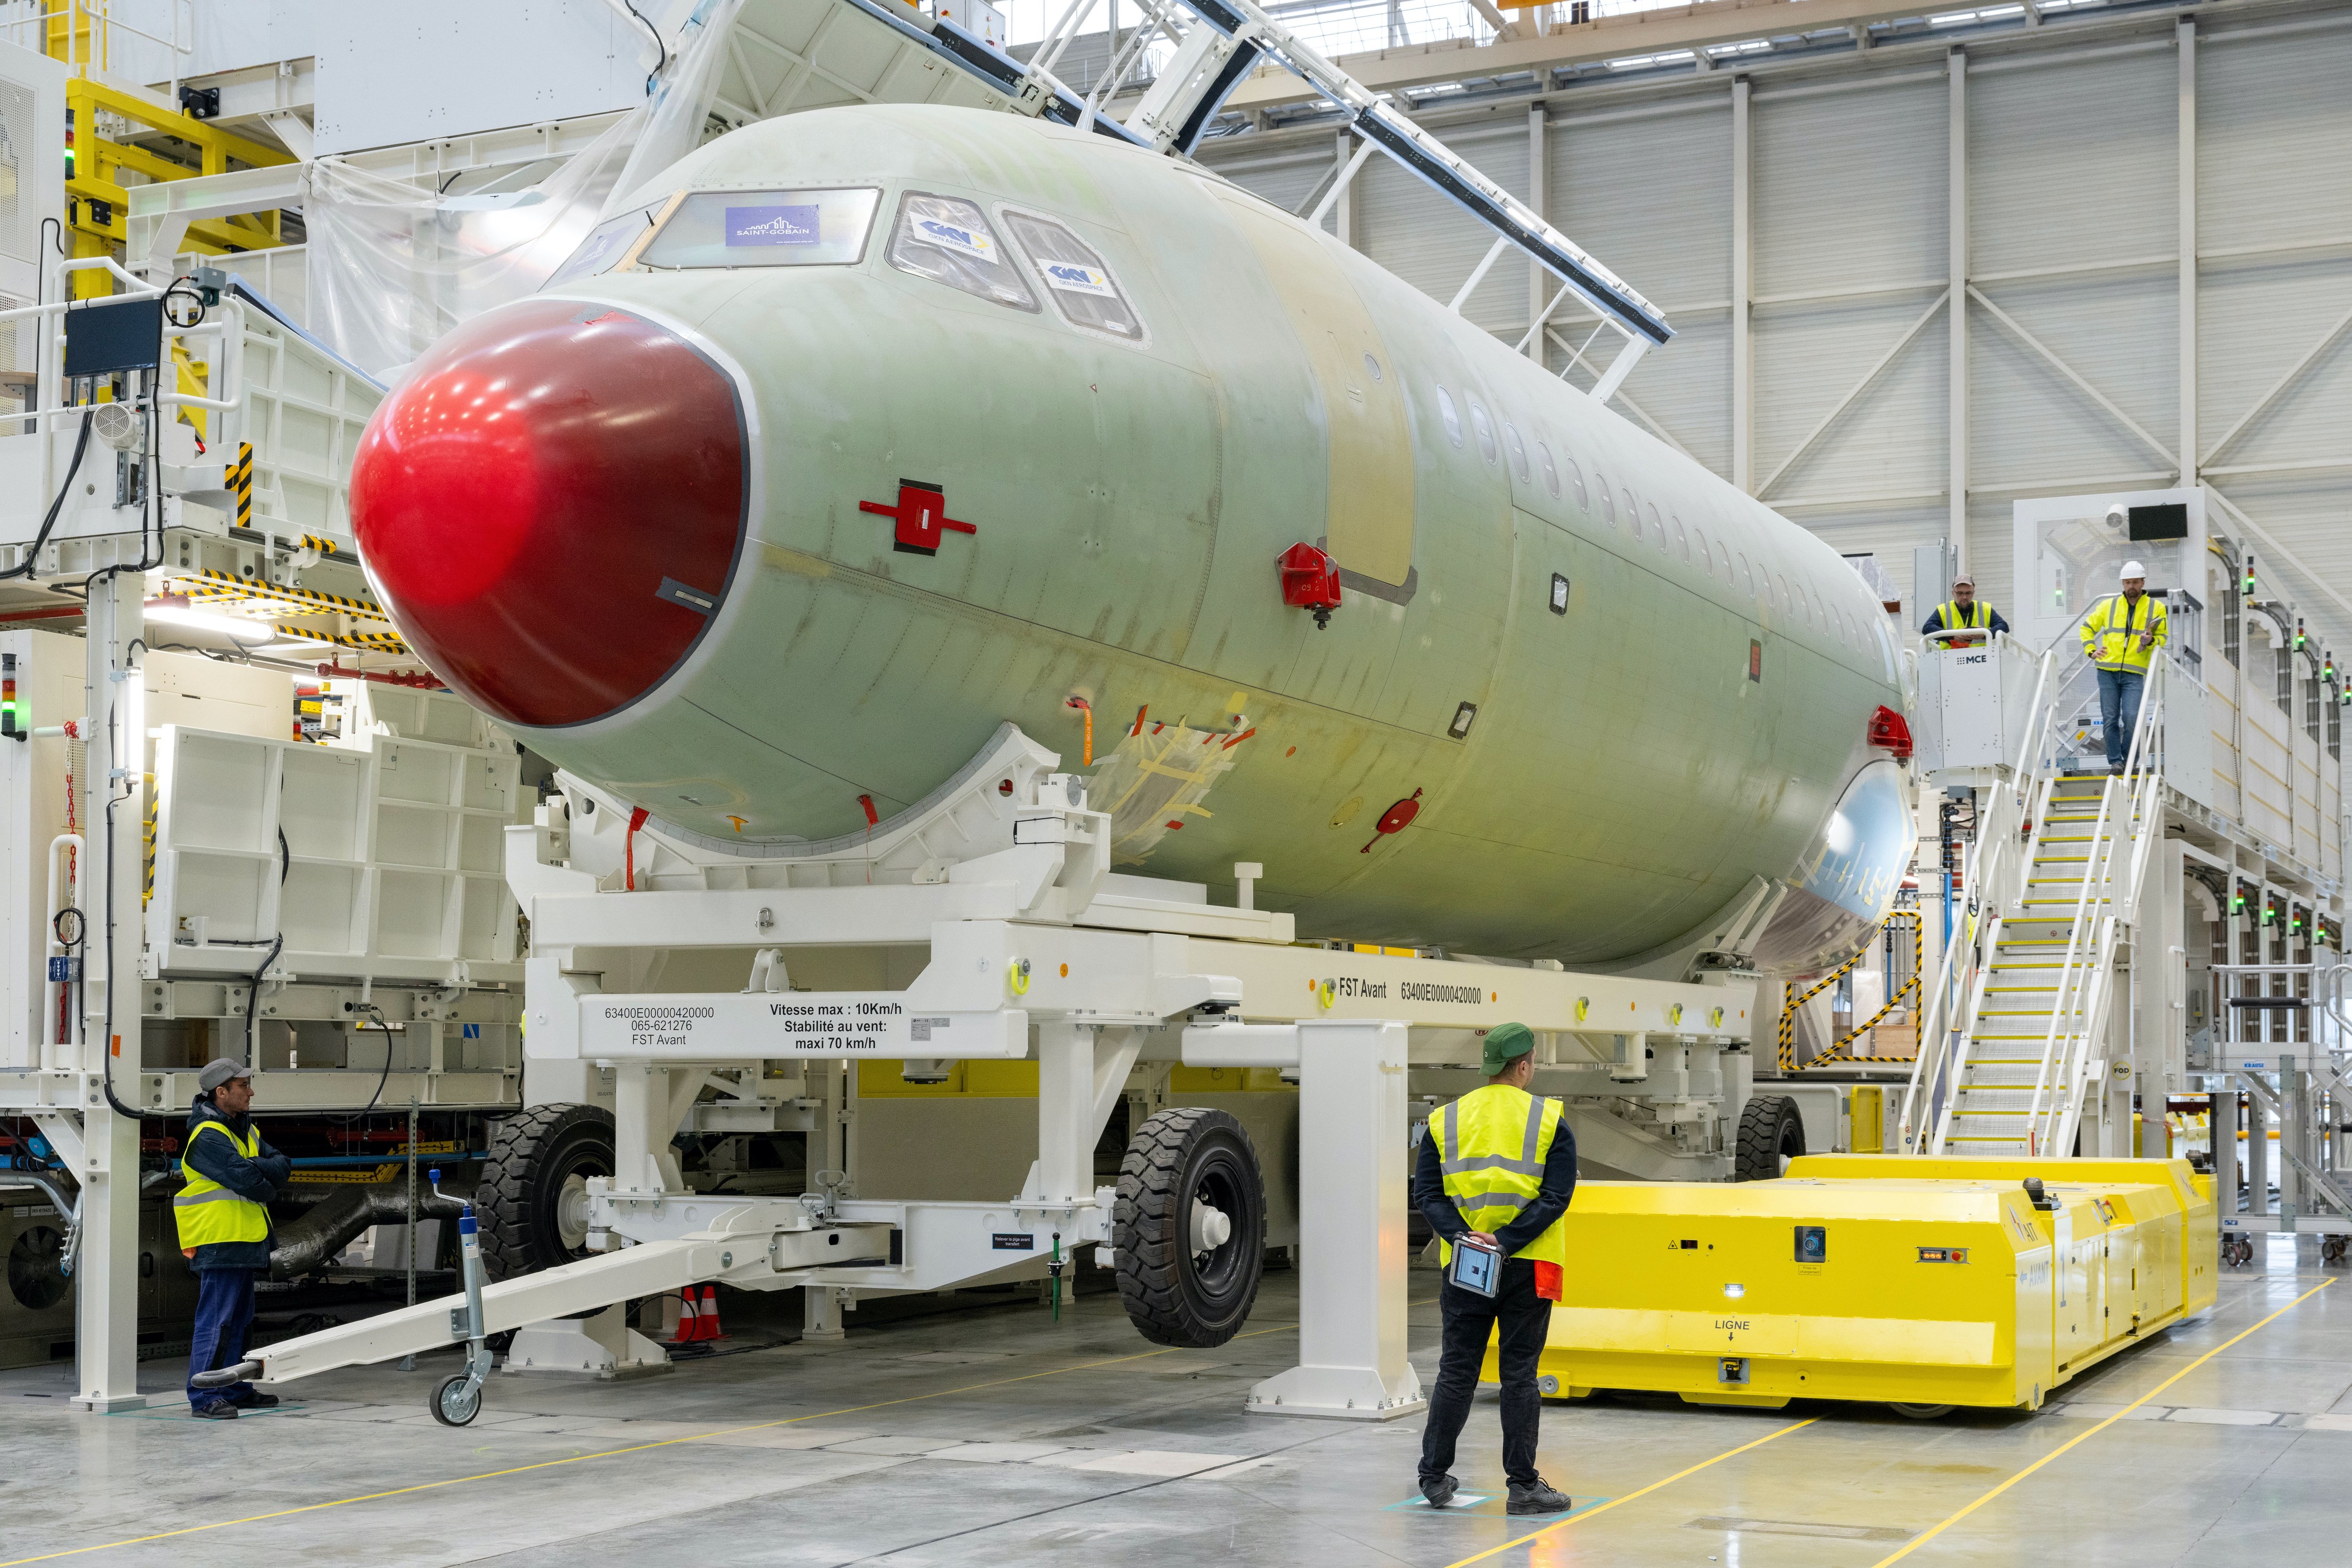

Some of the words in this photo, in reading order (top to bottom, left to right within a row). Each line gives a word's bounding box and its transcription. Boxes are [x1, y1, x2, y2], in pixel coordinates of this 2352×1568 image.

[929, 233, 944, 242] GKN
[946, 239, 985, 255] AEROSPACE
[1073, 283, 1104, 292] AEROSPACE
[1966, 655, 1986, 664] MCE
[1340, 977, 1359, 996] FST
[1360, 979, 1387, 998] Avant
[1401, 982, 1481, 1004] 63400E00000420000
[605, 1007, 714, 1018] 63400E00000420000
[770, 1004, 814, 1015] Vitesse
[818, 1006, 843, 1015] max
[848, 1006, 850, 1015] :
[856, 1003, 902, 1015] 10Km/h
[631, 1020, 692, 1031] 065-621276
[785, 1020, 834, 1032] Stabilité
[856, 1020, 887, 1031] vent:
[632, 1035, 654, 1044] FST
[657, 1035, 686, 1044] Avant
[795, 1038, 824, 1049] maxi
[828, 1037, 842, 1049] 70
[846, 1037, 876, 1049] km/h
[2023, 1222, 2038, 1242] AIT
[2029, 1260, 2049, 1287] AVANT
[1715, 1320, 1750, 1330] LIGNE
